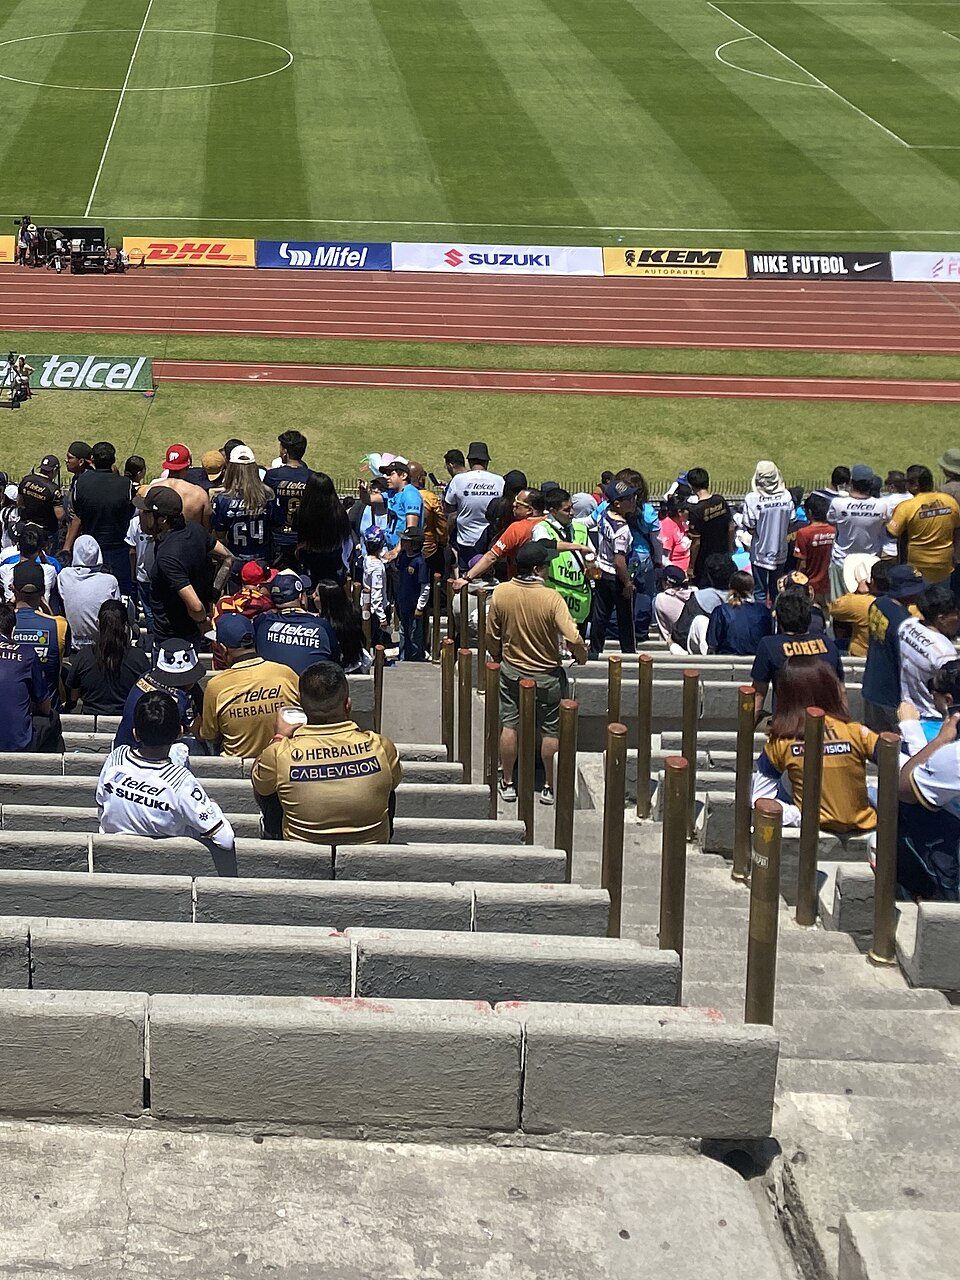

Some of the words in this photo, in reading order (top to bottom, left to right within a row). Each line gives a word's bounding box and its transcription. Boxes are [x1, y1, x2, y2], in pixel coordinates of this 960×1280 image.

[146, 243, 231, 260] DHL
[313, 245, 368, 267] Mifel
[468, 253, 551, 267] SUZUKI
[639, 250, 723, 264] KEM
[644, 268, 706, 276] AUTOPARTES
[752, 255, 789, 273] NIKE
[792, 255, 848, 274] FUTBOL
[40, 354, 146, 389] telcel
[847, 502, 877, 511] telcel
[233, 519, 264, 547] 64
[282, 622, 320, 638] telcel
[908, 627, 936, 648] telcel
[267, 632, 320, 649] HERBALIFE
[782, 638, 828, 657] COHEN
[244, 685, 282, 703] telcel
[305, 741, 371, 761] HERBALIFE
[290, 759, 379, 780] CABLEVISION
[121, 776, 167, 797] telcel
[115, 787, 171, 812] SUZUKI
